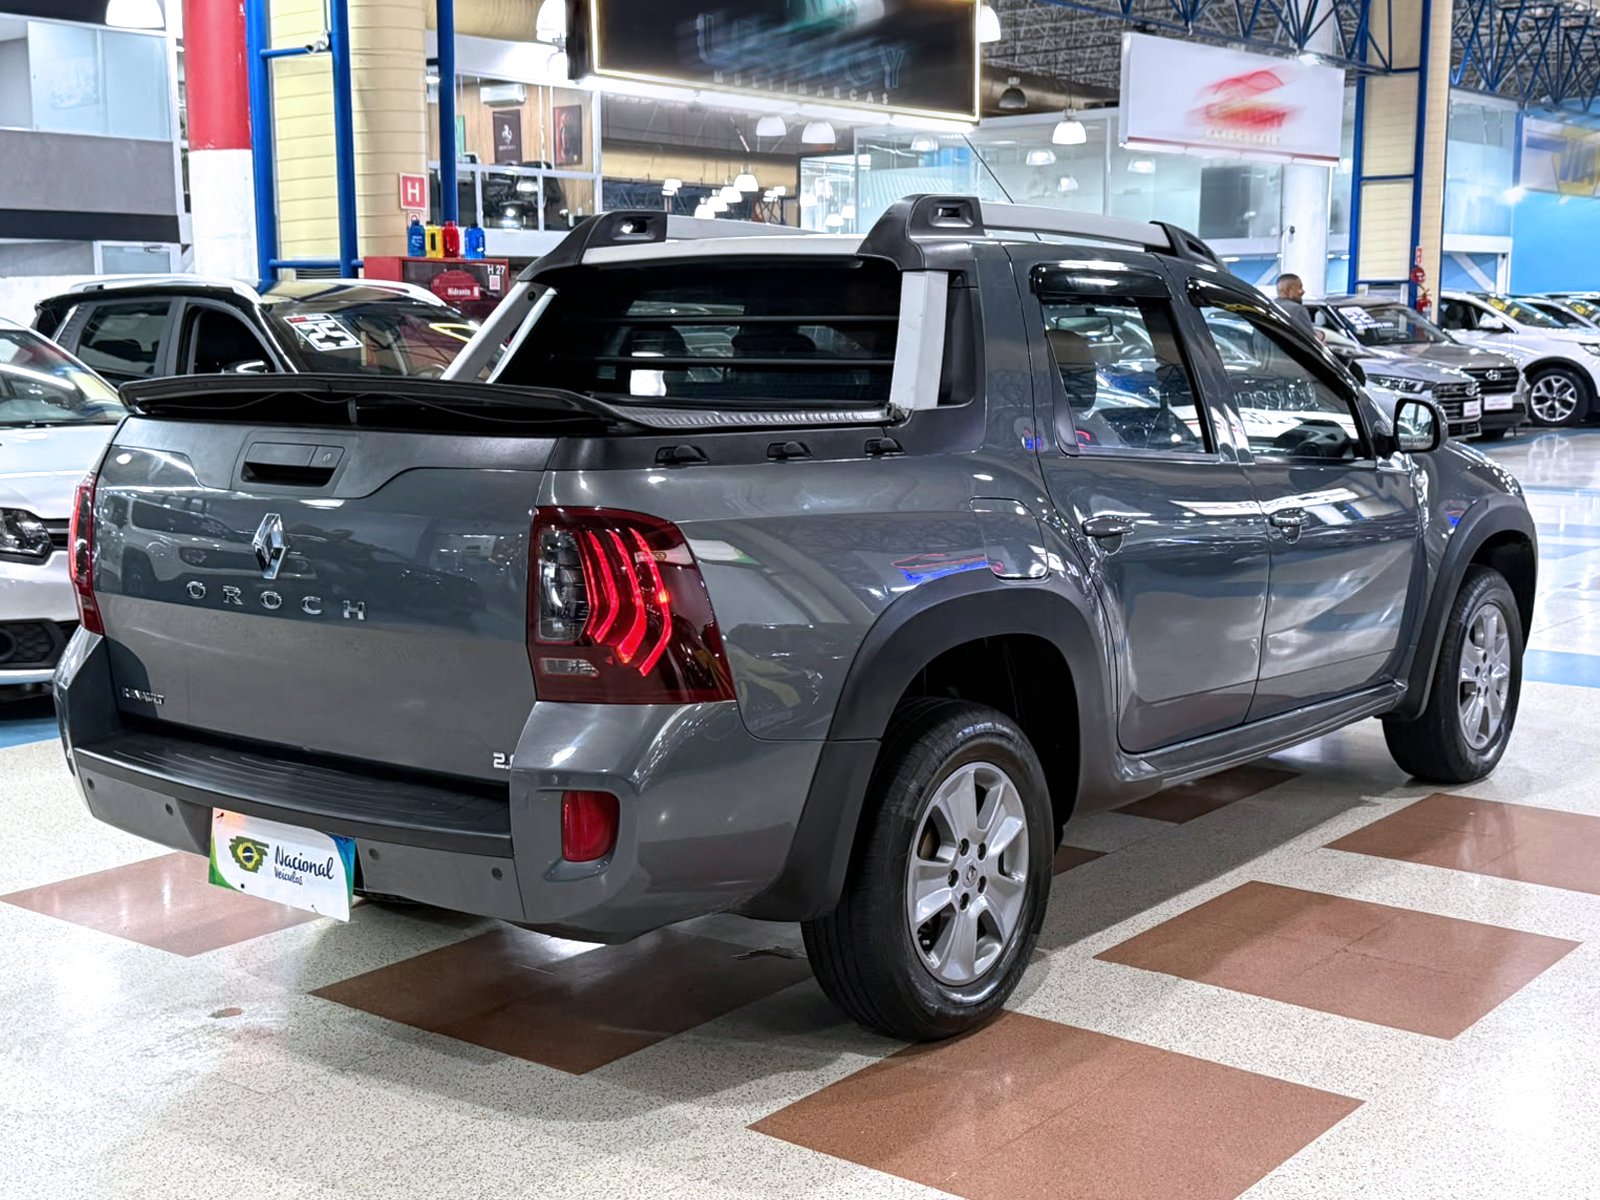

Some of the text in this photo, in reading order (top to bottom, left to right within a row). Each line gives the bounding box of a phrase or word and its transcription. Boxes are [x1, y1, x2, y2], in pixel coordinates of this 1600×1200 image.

[713, 69, 889, 105] MULTIMARCAS
[406, 180, 420, 203] H
[487, 264, 506, 275] H 27
[447, 287, 471, 296] Hidrante
[297, 322, 357, 348] 25
[186, 580, 366, 620] OROCH
[274, 845, 335, 880] Nacional
